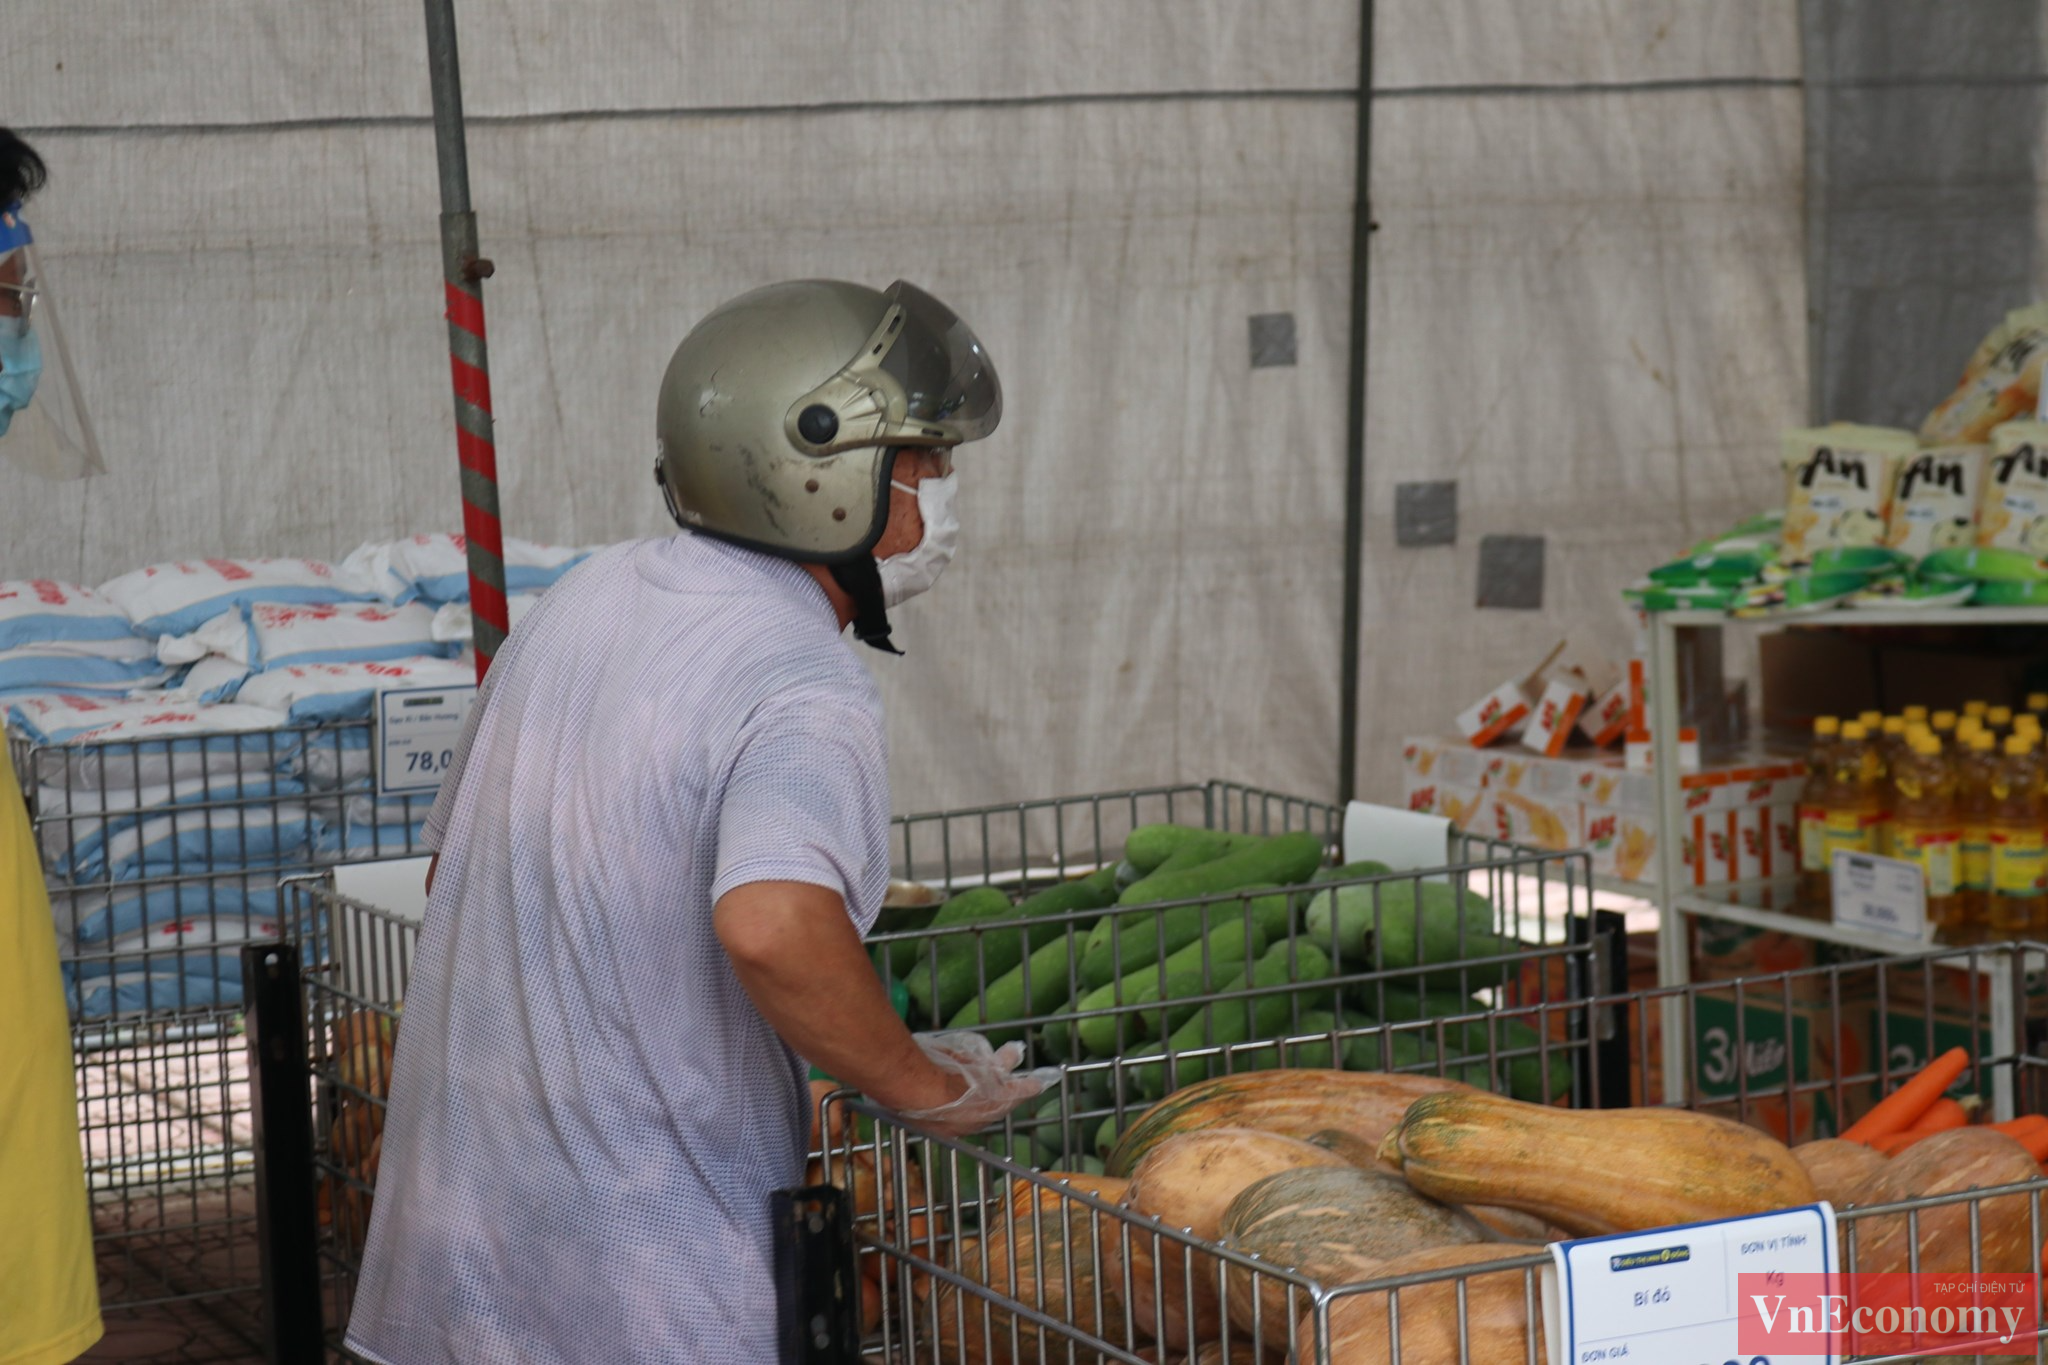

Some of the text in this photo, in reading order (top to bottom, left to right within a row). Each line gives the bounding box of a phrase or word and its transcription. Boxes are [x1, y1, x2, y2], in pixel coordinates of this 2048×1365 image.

[1798, 445, 1869, 491] An
[1900, 455, 1965, 500] An
[405, 748, 453, 774] 78,0
[1703, 1026, 1729, 1084] 3
[1633, 1289, 1650, 1307] Bí
